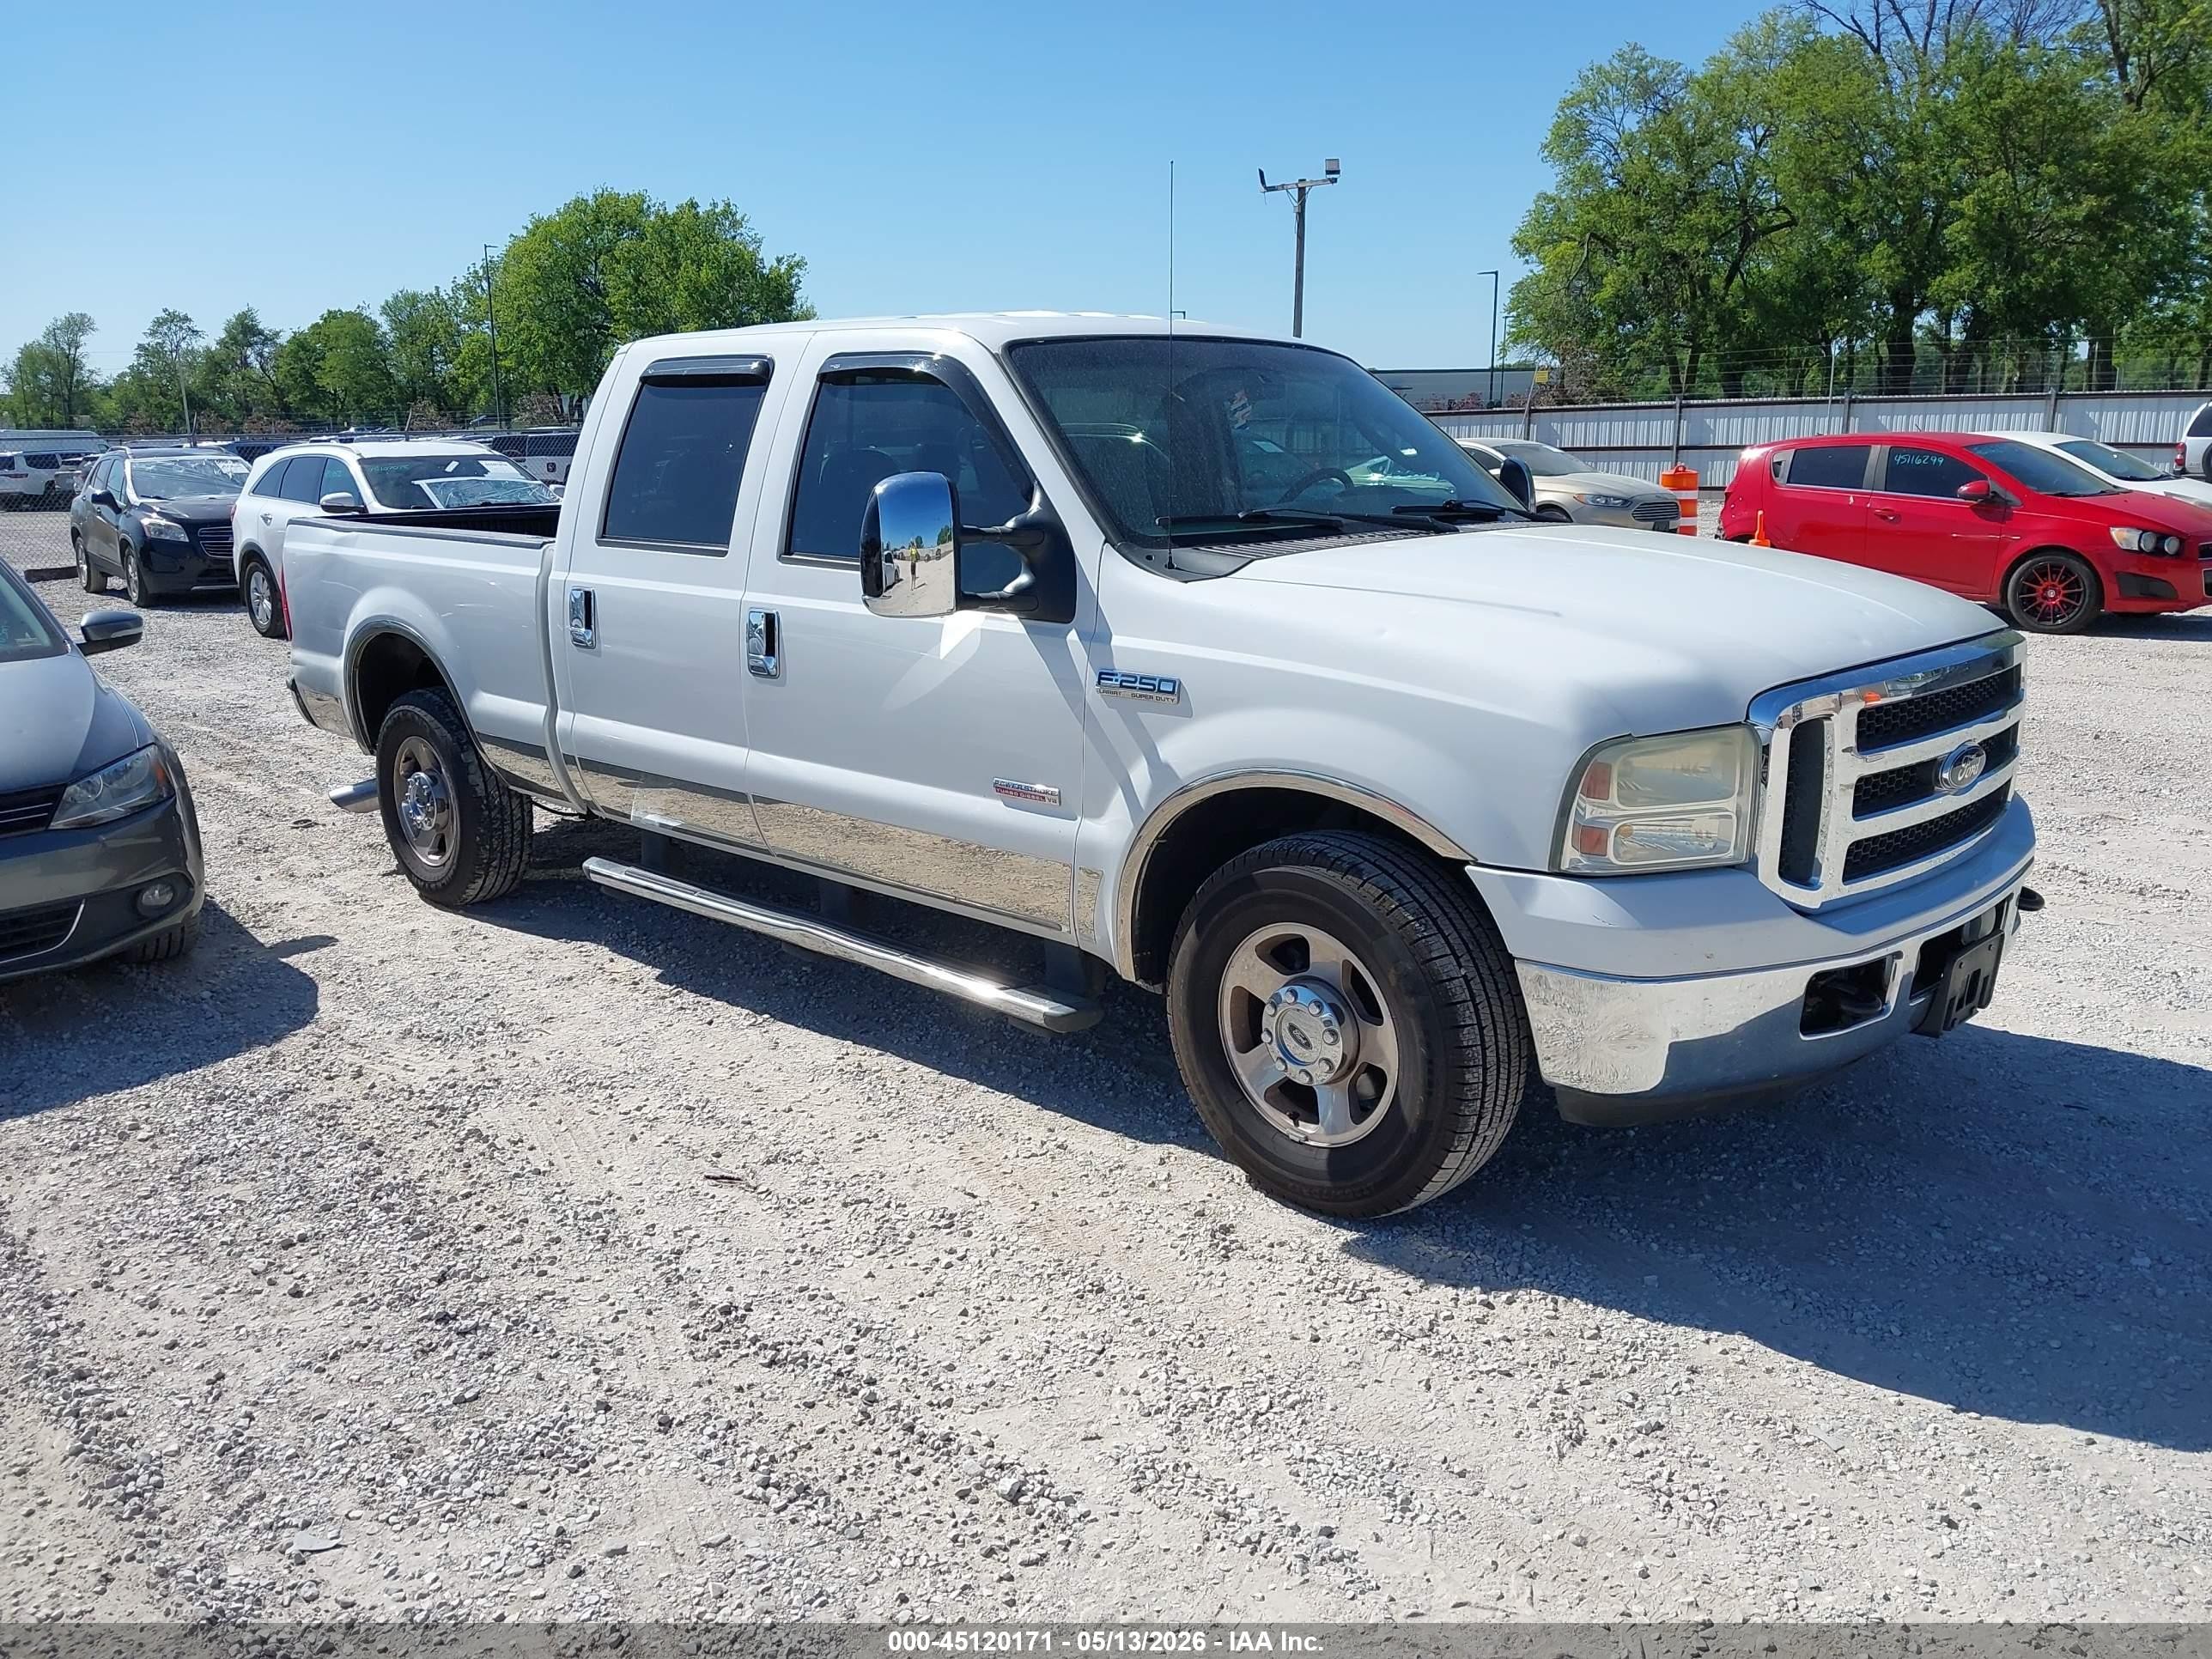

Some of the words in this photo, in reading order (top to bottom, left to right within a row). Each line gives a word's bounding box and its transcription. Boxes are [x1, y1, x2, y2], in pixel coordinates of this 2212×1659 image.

[1894, 453, 1944, 465] 45116299
[1097, 672, 1177, 695] F-250
[1131, 692, 1154, 701] SUPER
[1957, 755, 1981, 781] Ford
